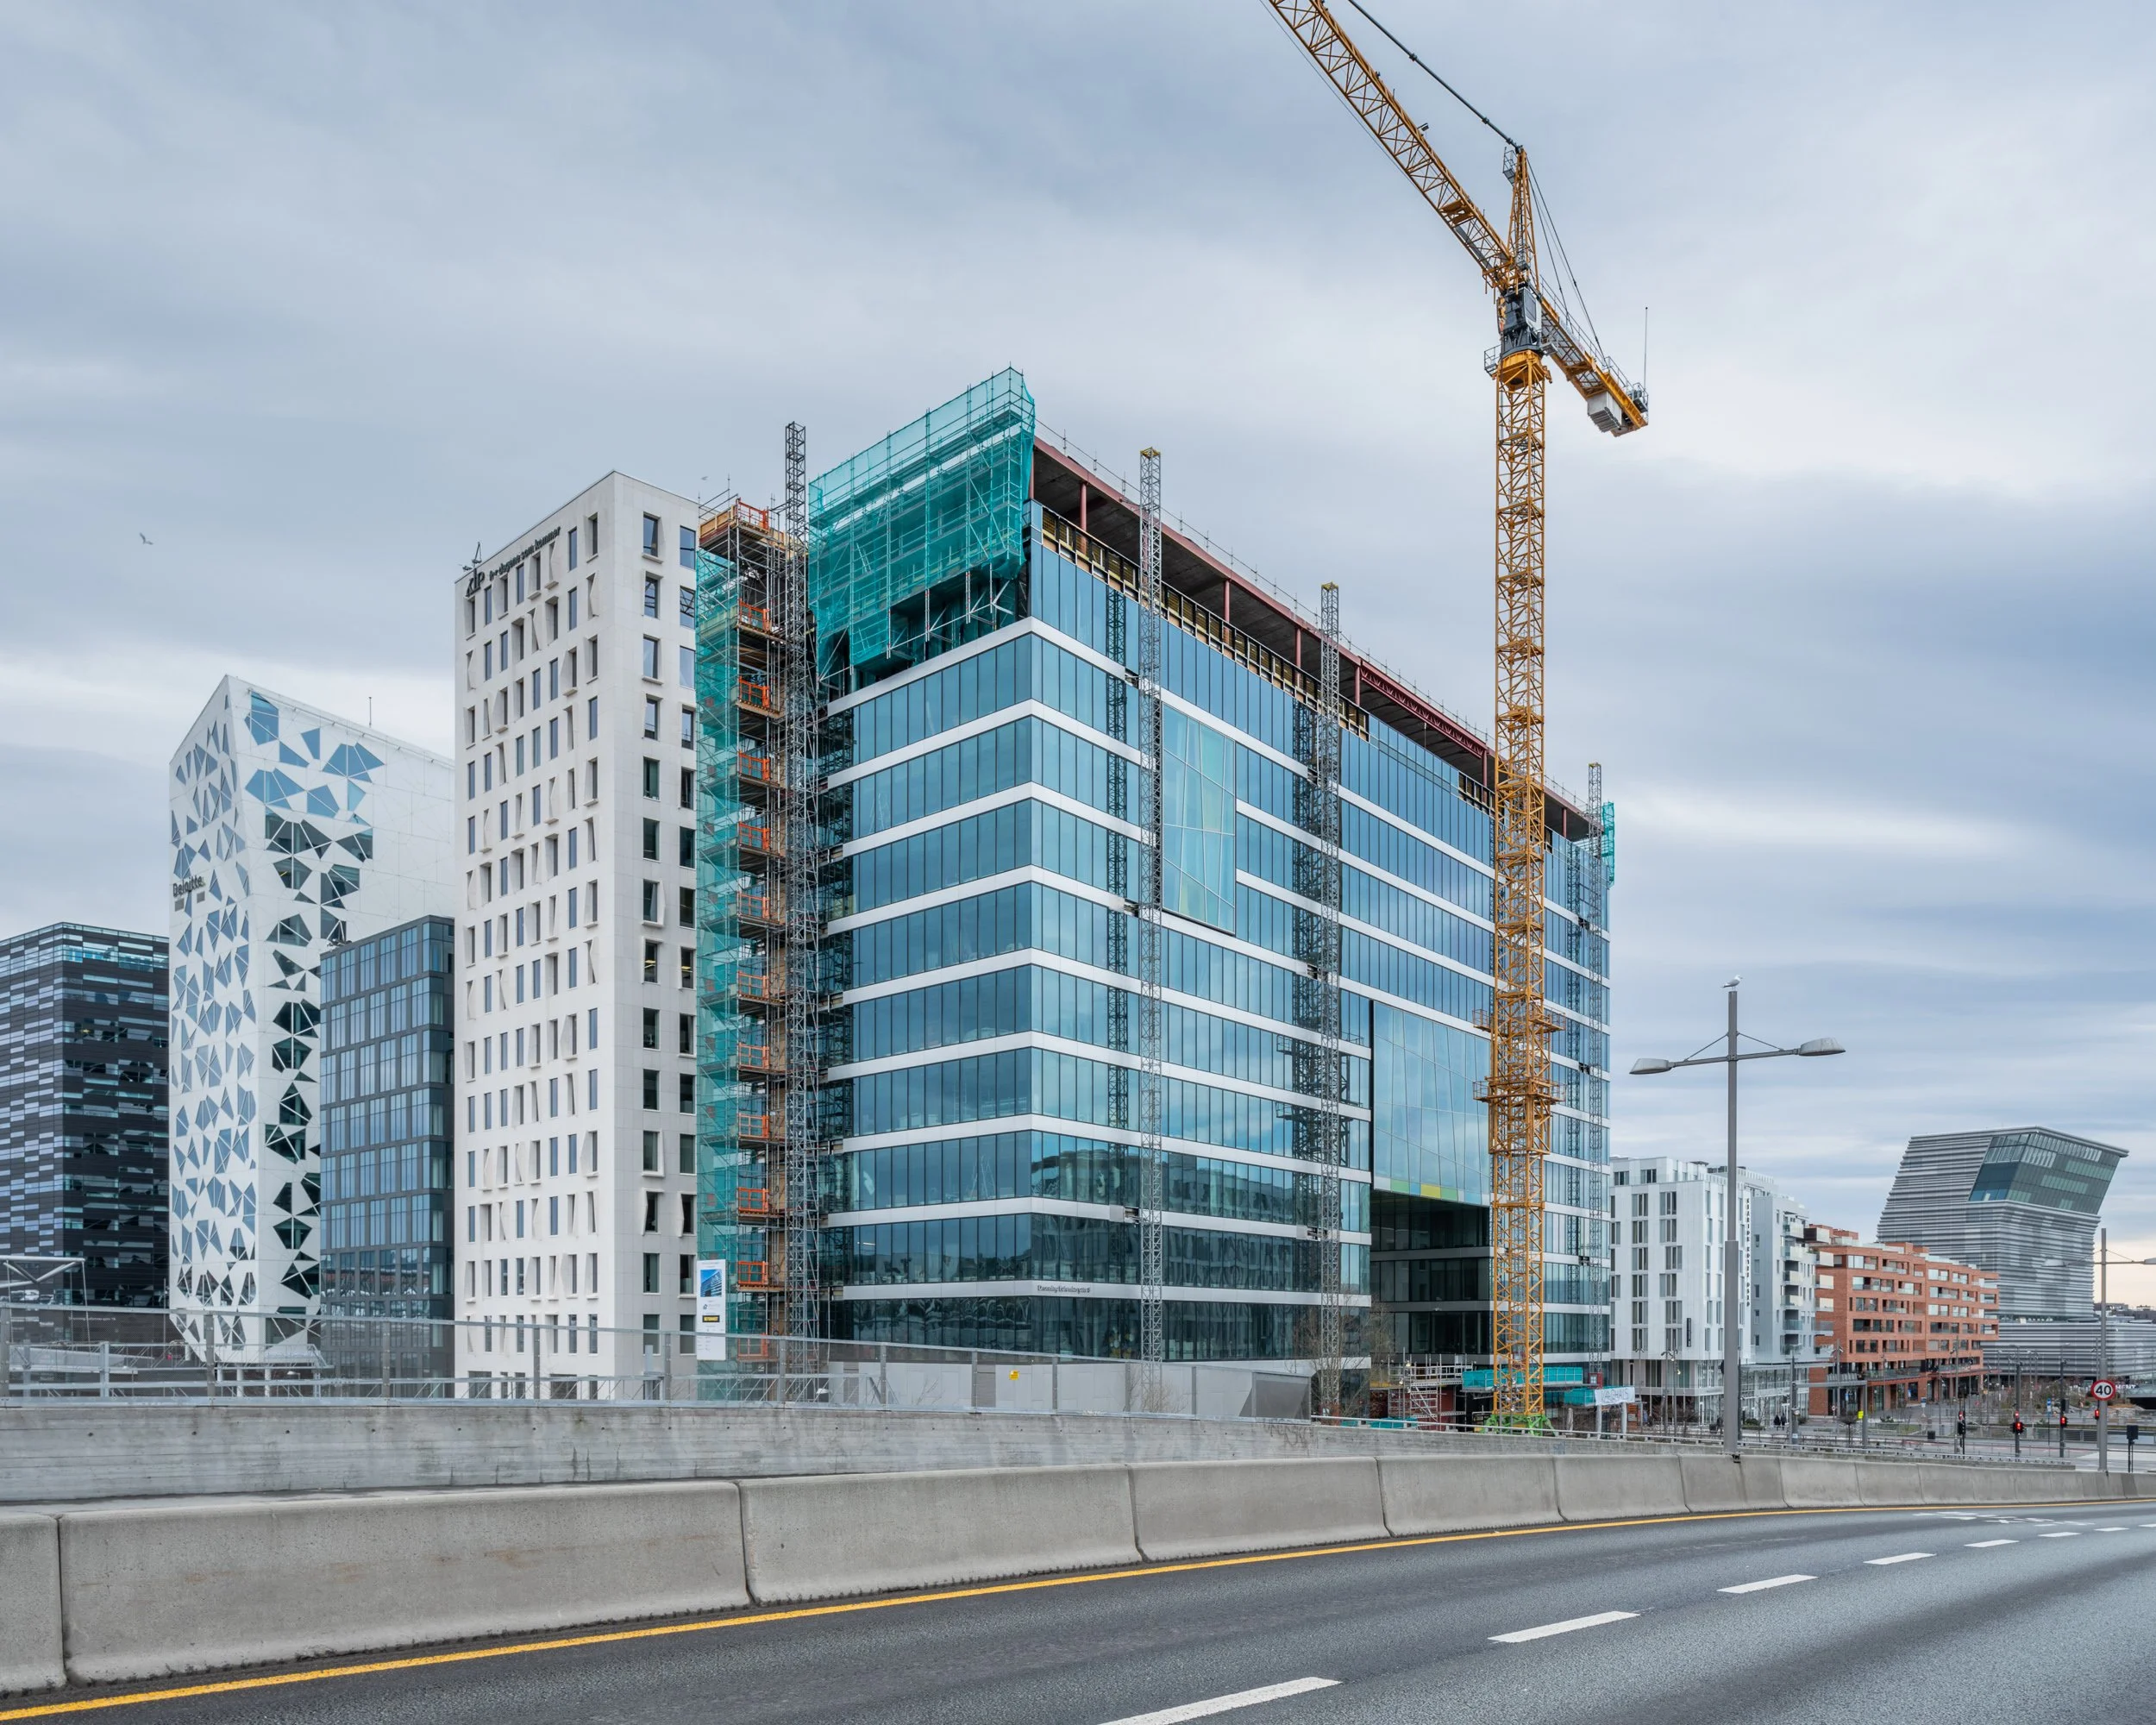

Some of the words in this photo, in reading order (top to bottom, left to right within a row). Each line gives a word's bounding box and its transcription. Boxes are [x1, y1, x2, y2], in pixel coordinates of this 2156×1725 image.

[535, 526, 561, 550] kommer
[172, 875, 205, 897] Deloitte
[2096, 1385, 2111, 1396] 40
